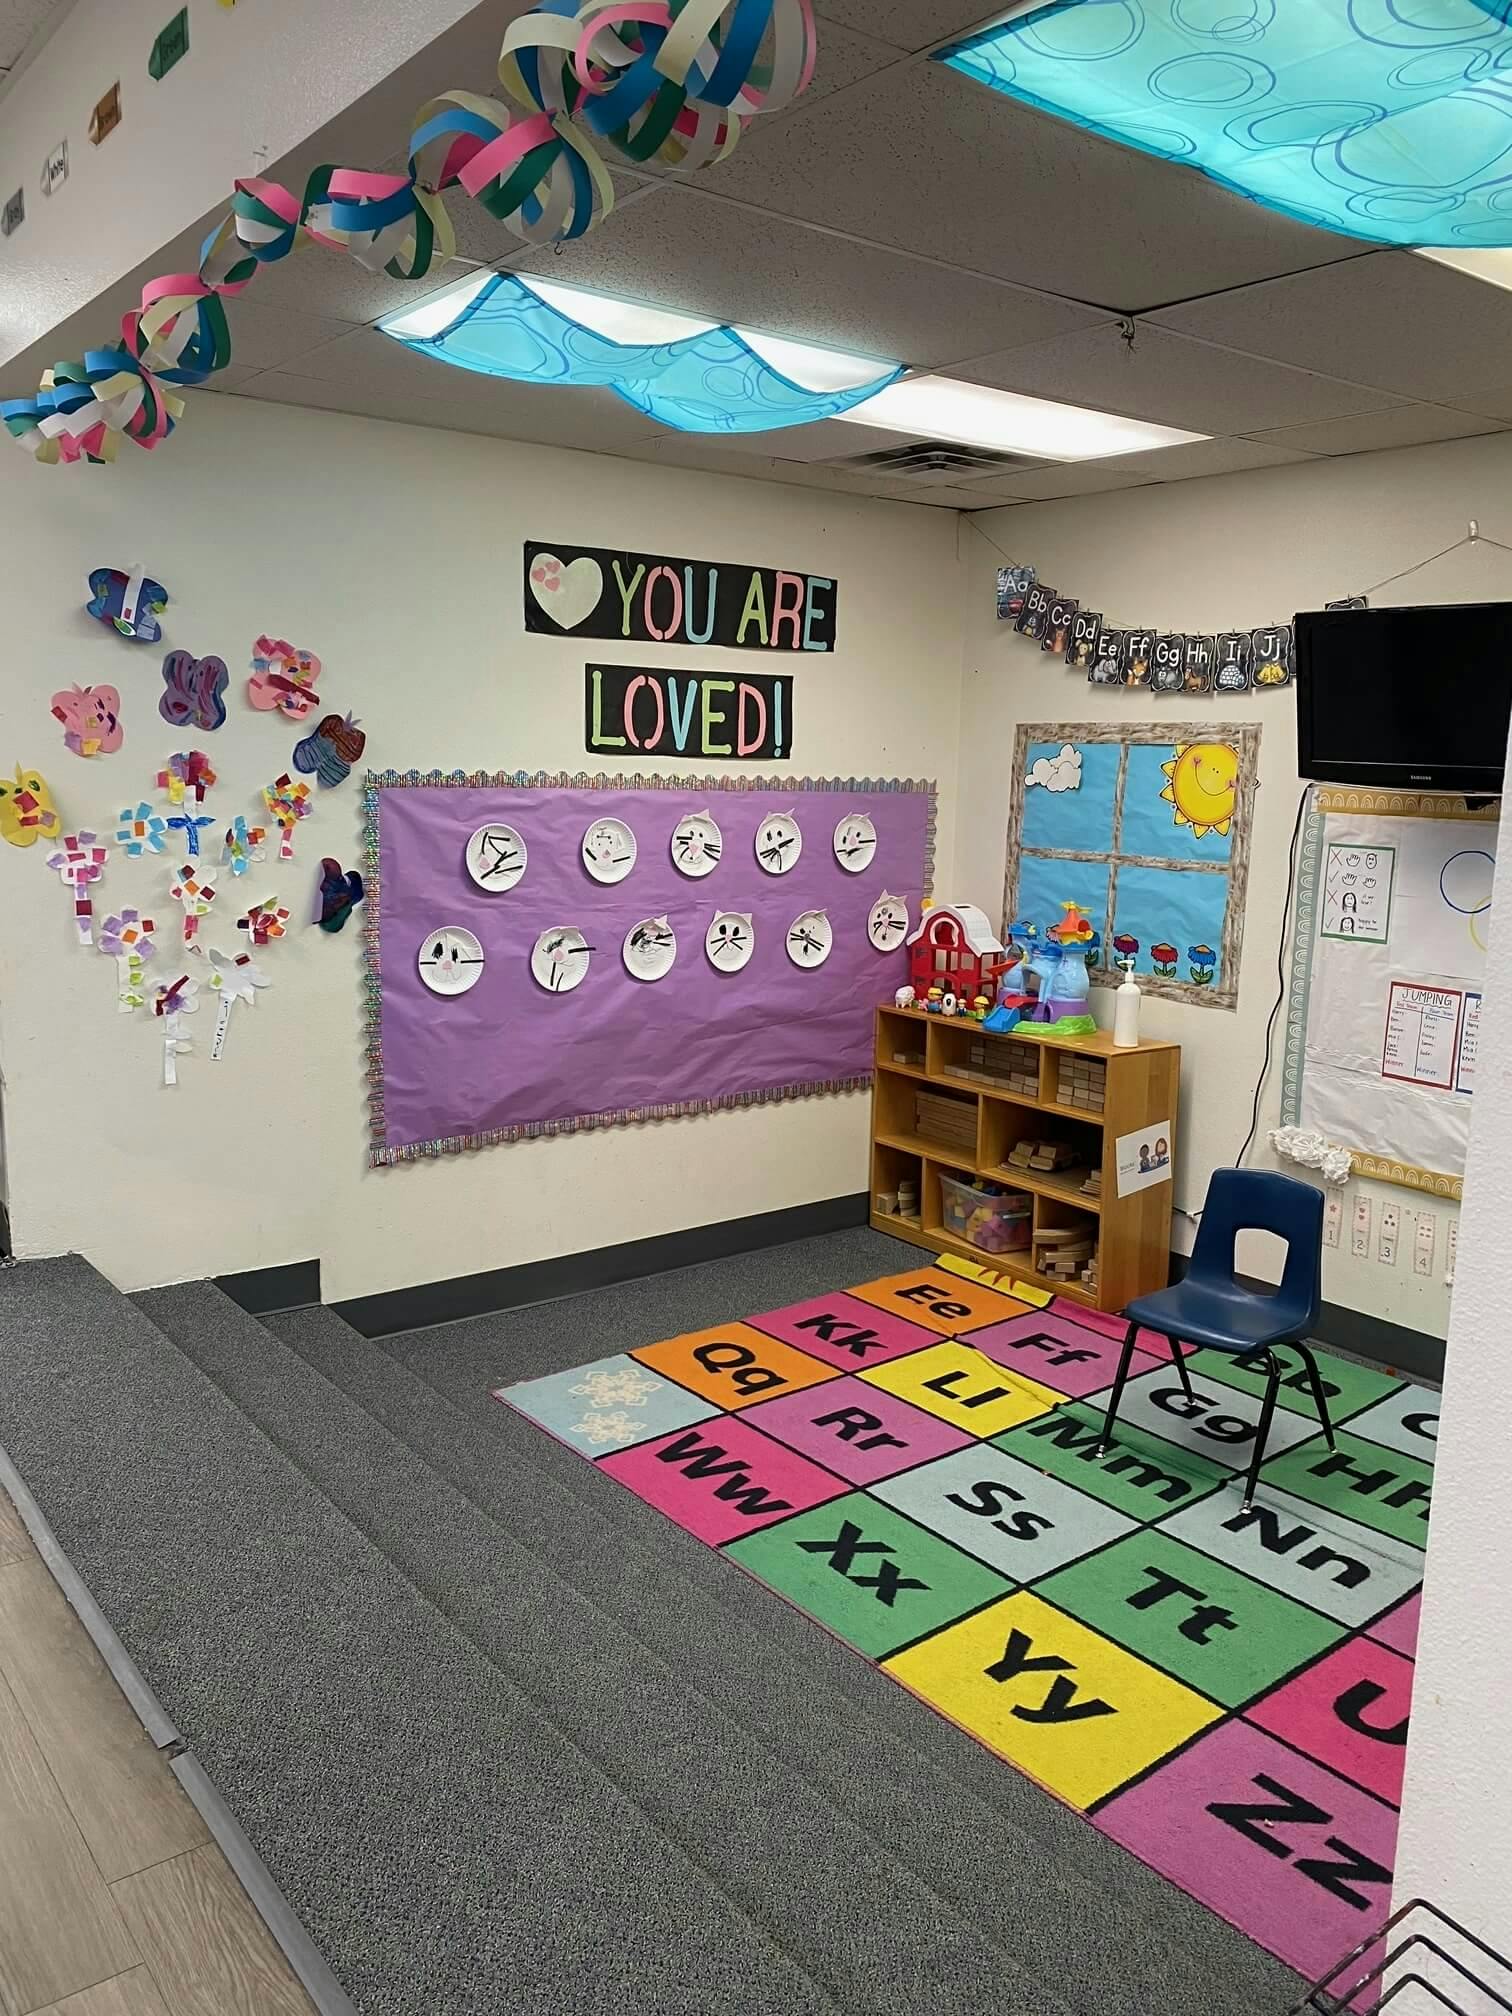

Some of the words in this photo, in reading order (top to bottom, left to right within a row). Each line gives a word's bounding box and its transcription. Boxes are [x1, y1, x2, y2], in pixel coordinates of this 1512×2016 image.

[1004, 574, 1028, 593] Aa
[1028, 590, 1047, 613] Bb
[612, 560, 718, 644] YOU
[736, 571, 832, 651] ARE
[1051, 606, 1071, 626] Cc
[1075, 619, 1096, 639] Dd
[1098, 635, 1118, 656] Ee
[1129, 637, 1150, 657] Ff
[1260, 635, 1280, 661] Jj
[1156, 642, 1180, 667] Gg
[1187, 643, 1208, 663] Hh
[1226, 641, 1241, 665] Ii
[591, 671, 782, 758] LOVED!
[1402, 988, 1452, 1006] JUMPING
[895, 1283, 972, 1320] Ee
[795, 1314, 888, 1359] Kk
[1008, 1332, 1102, 1367] Ff
[693, 1342, 789, 1397] Qq
[922, 1370, 1011, 1408] Ll
[811, 1406, 909, 1454] Rr
[1148, 1387, 1261, 1444] Gg
[655, 1431, 795, 1516] Ww
[1027, 1416, 1195, 1503] Mm
[944, 1481, 1056, 1541] Ss
[795, 1520, 933, 1608] Xx
[1220, 1505, 1372, 1590] Nn
[1124, 1566, 1239, 1646] Tt
[983, 1627, 1119, 1725] Yy
[1206, 1772, 1394, 1912] Zz
